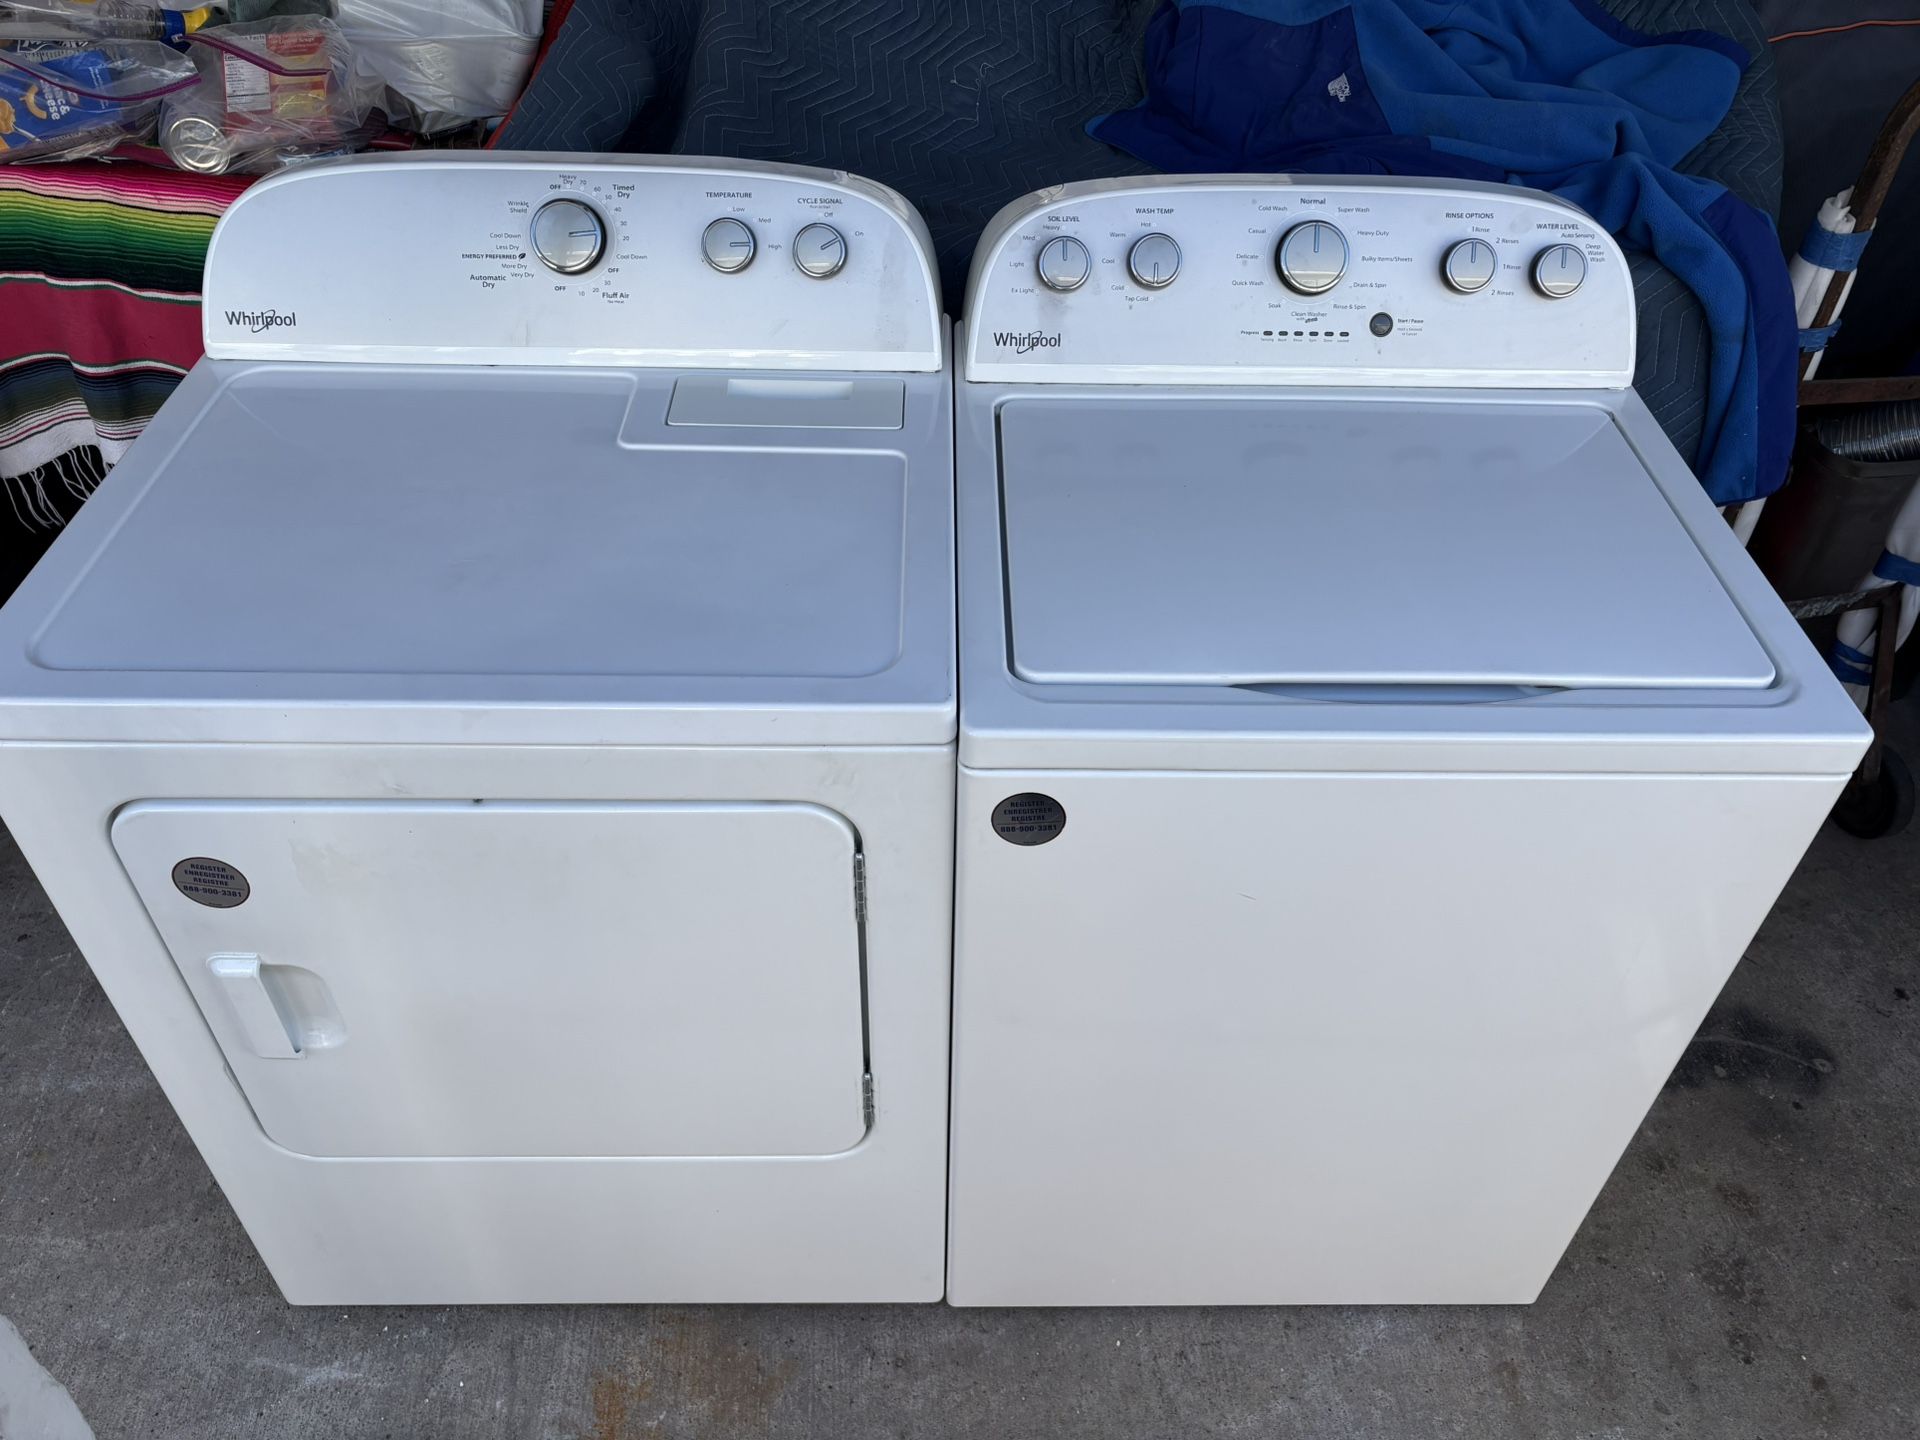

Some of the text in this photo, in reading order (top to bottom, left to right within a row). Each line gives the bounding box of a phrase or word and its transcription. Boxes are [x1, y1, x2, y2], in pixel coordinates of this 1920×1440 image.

[617, 191, 630, 199] Dry
[1574, 232, 1595, 240] Sensing
[482, 281, 495, 289] Dry
[1019, 287, 1035, 295] Light
[1125, 295, 1135, 303] Tap
[1353, 303, 1366, 311] Spin
[225, 310, 296, 330] Whirlpool
[993, 331, 1061, 351] Whirlpool
[190, 863, 226, 873] REGISTER
[184, 869, 235, 881] ENREGISTRER
[193, 877, 229, 887] REGISTRE
